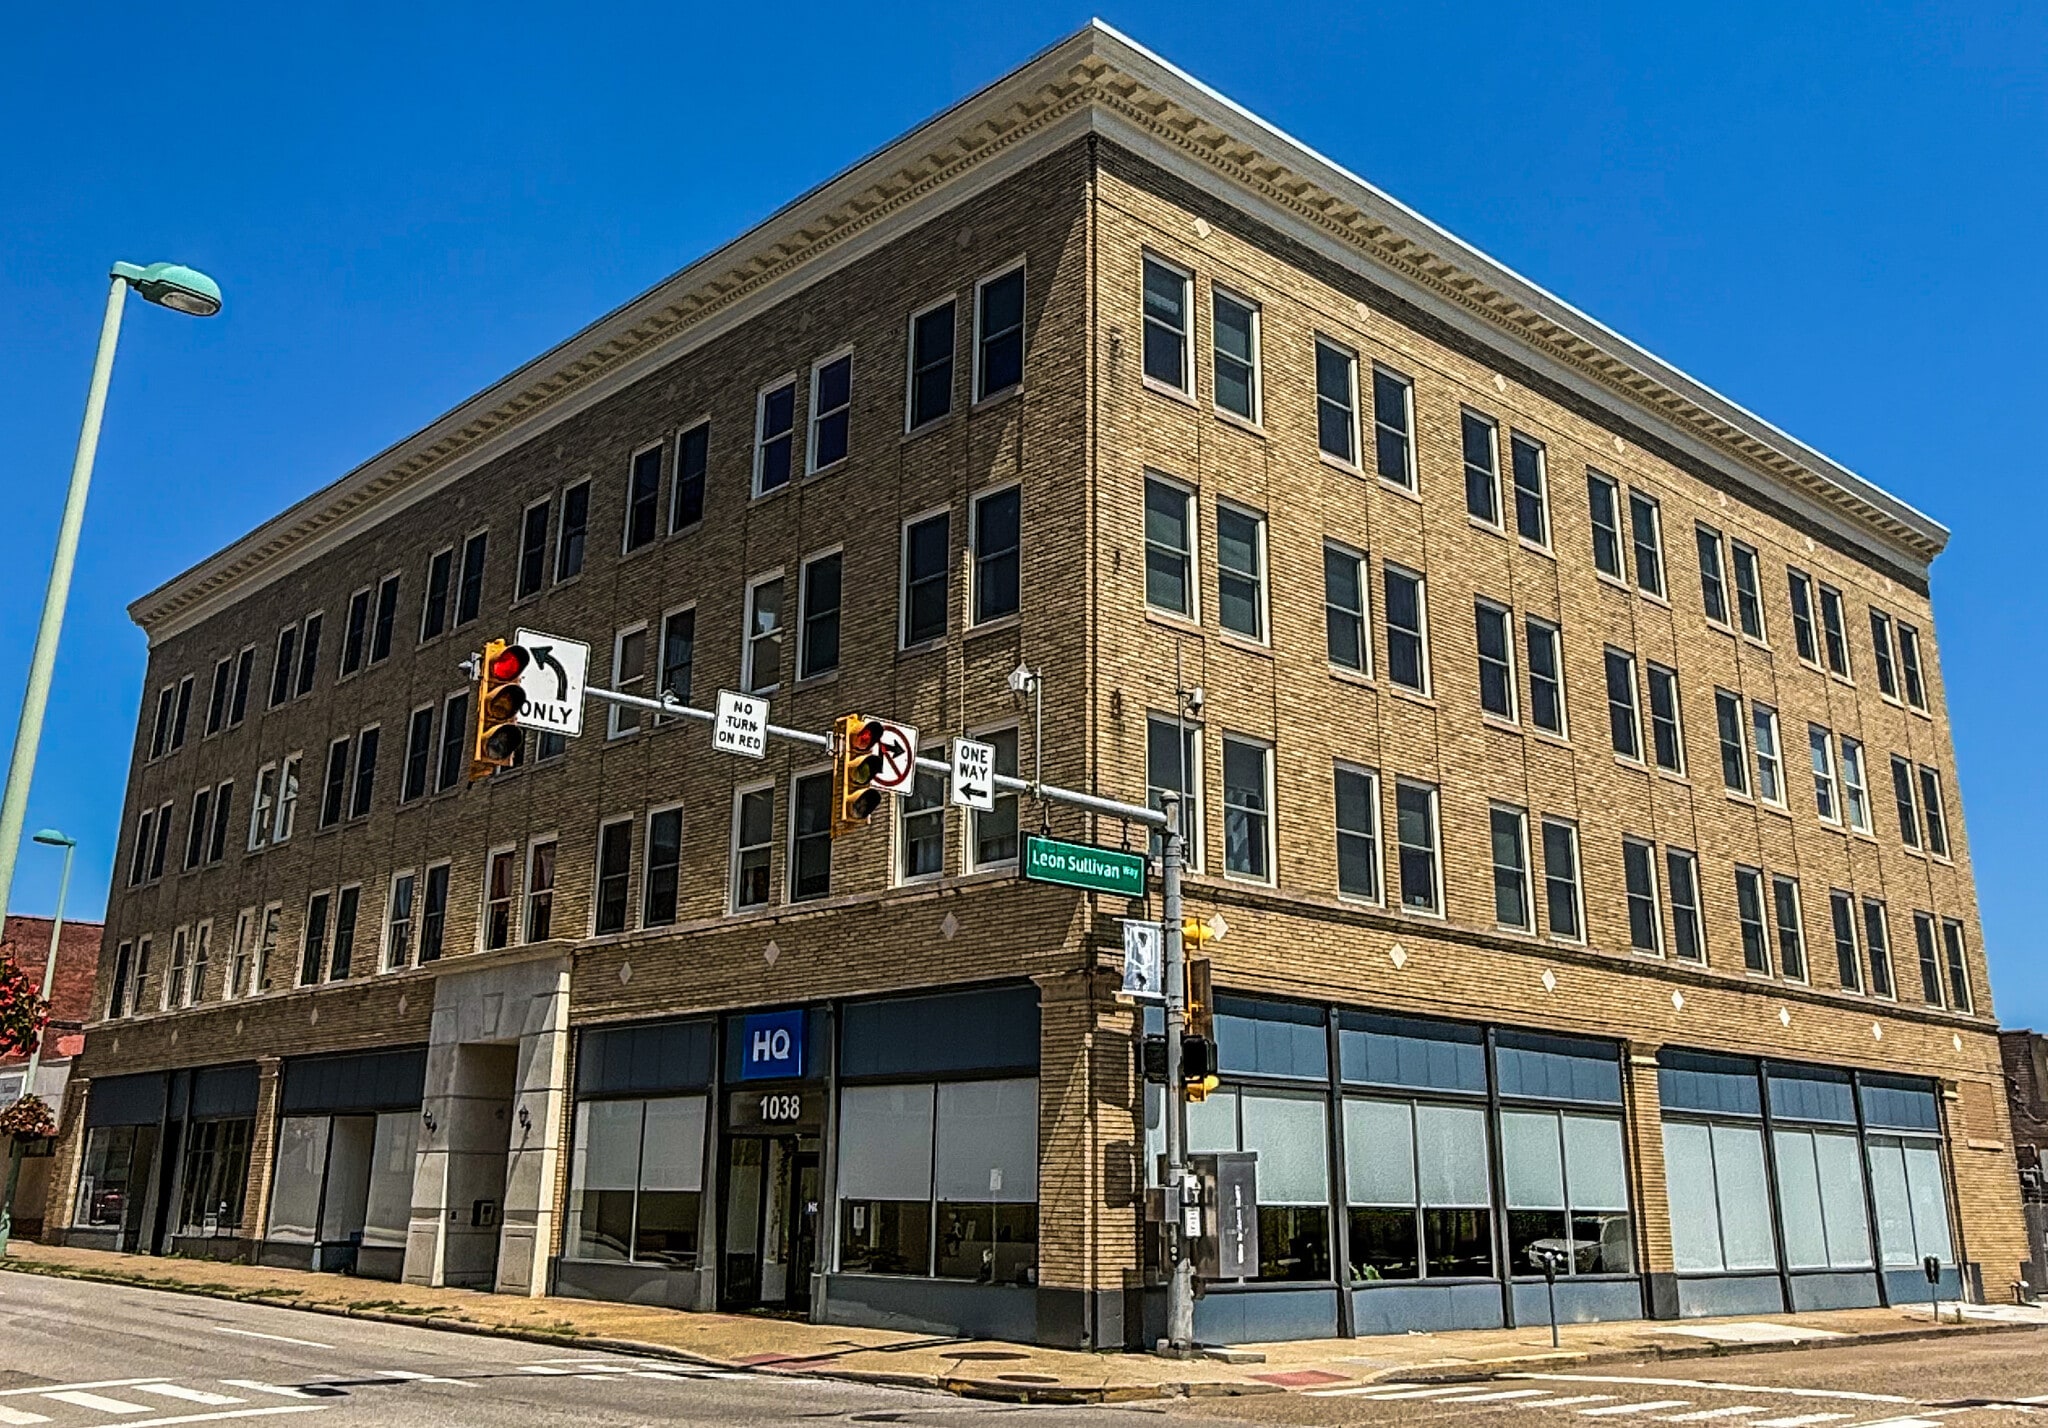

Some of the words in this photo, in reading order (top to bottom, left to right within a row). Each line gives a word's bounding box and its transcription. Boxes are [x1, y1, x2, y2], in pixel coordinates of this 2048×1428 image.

[519, 700, 573, 725] ONLY
[733, 700, 753, 716] NO
[726, 715, 758, 732] TURN
[719, 731, 735, 744] ON
[739, 734, 761, 750] RED
[961, 745, 988, 764] ONE
[960, 762, 988, 781] WAY
[1032, 849, 1065, 870] Leon
[1068, 855, 1120, 880] Sullivan
[1122, 865, 1139, 880] Way
[753, 1028, 791, 1062] HQ
[760, 1095, 800, 1120] 1038
